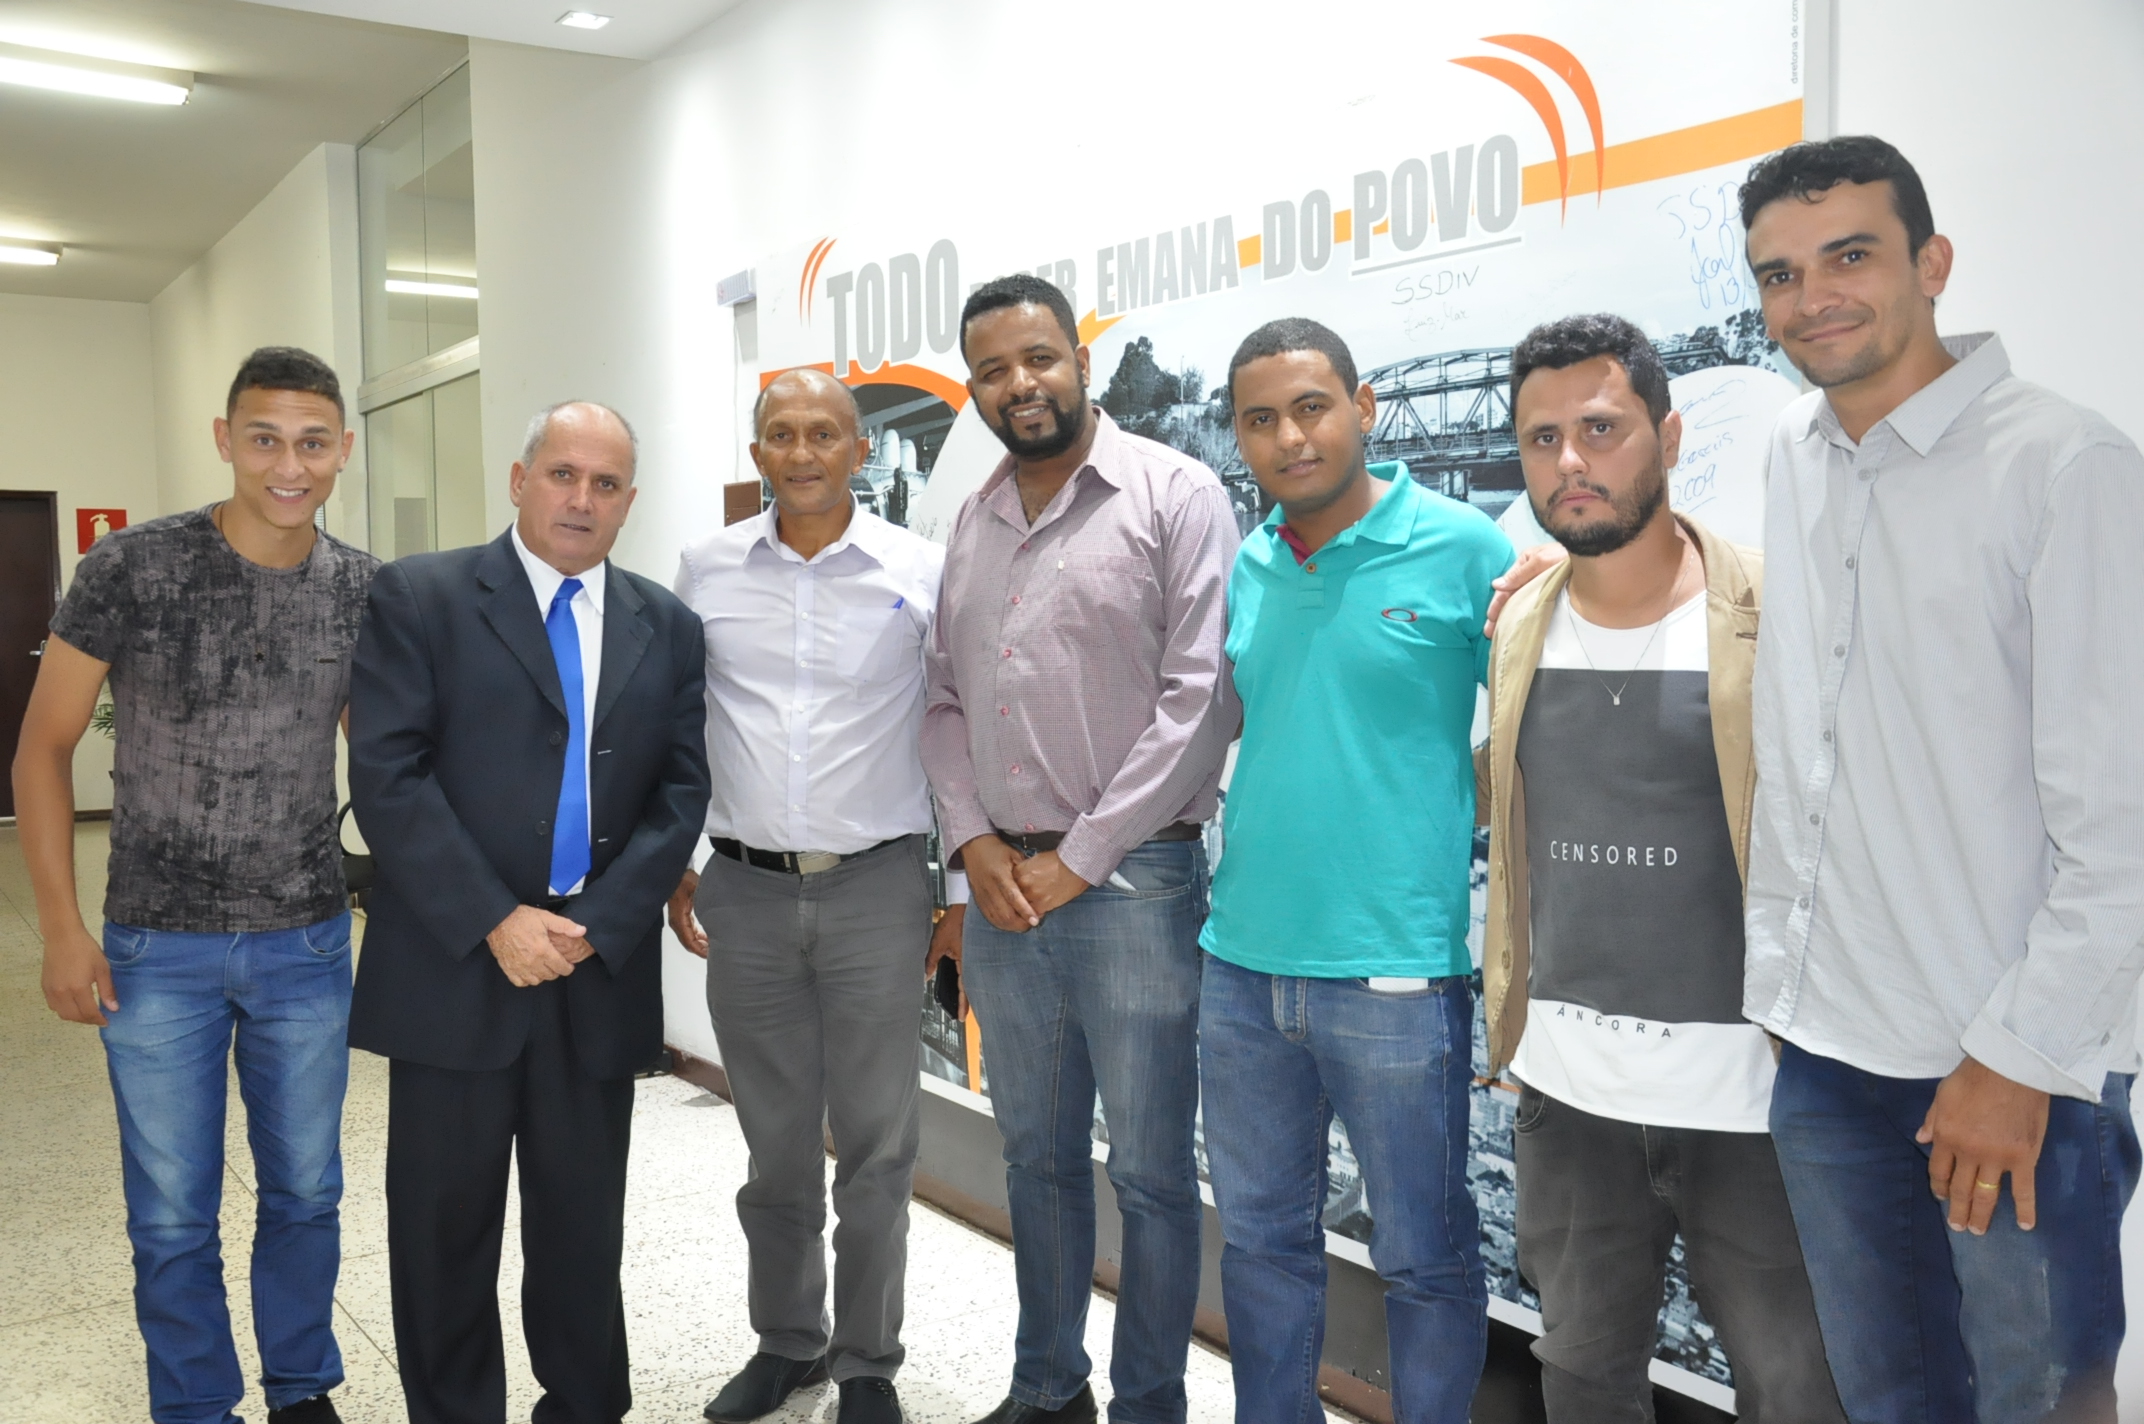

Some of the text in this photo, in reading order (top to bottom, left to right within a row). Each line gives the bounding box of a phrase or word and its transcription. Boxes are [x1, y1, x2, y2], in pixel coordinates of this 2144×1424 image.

[1791, 25, 1799, 38] de
[826, 238, 960, 377] TODO
[1096, 214, 1240, 317] EMANA
[1262, 188, 1332, 281] DO
[1353, 134, 1519, 261] POVO
[1391, 265, 1480, 305] SSDIV
[1670, 463, 1717, 509] 2009
[1550, 840, 1678, 867] CENSORED
